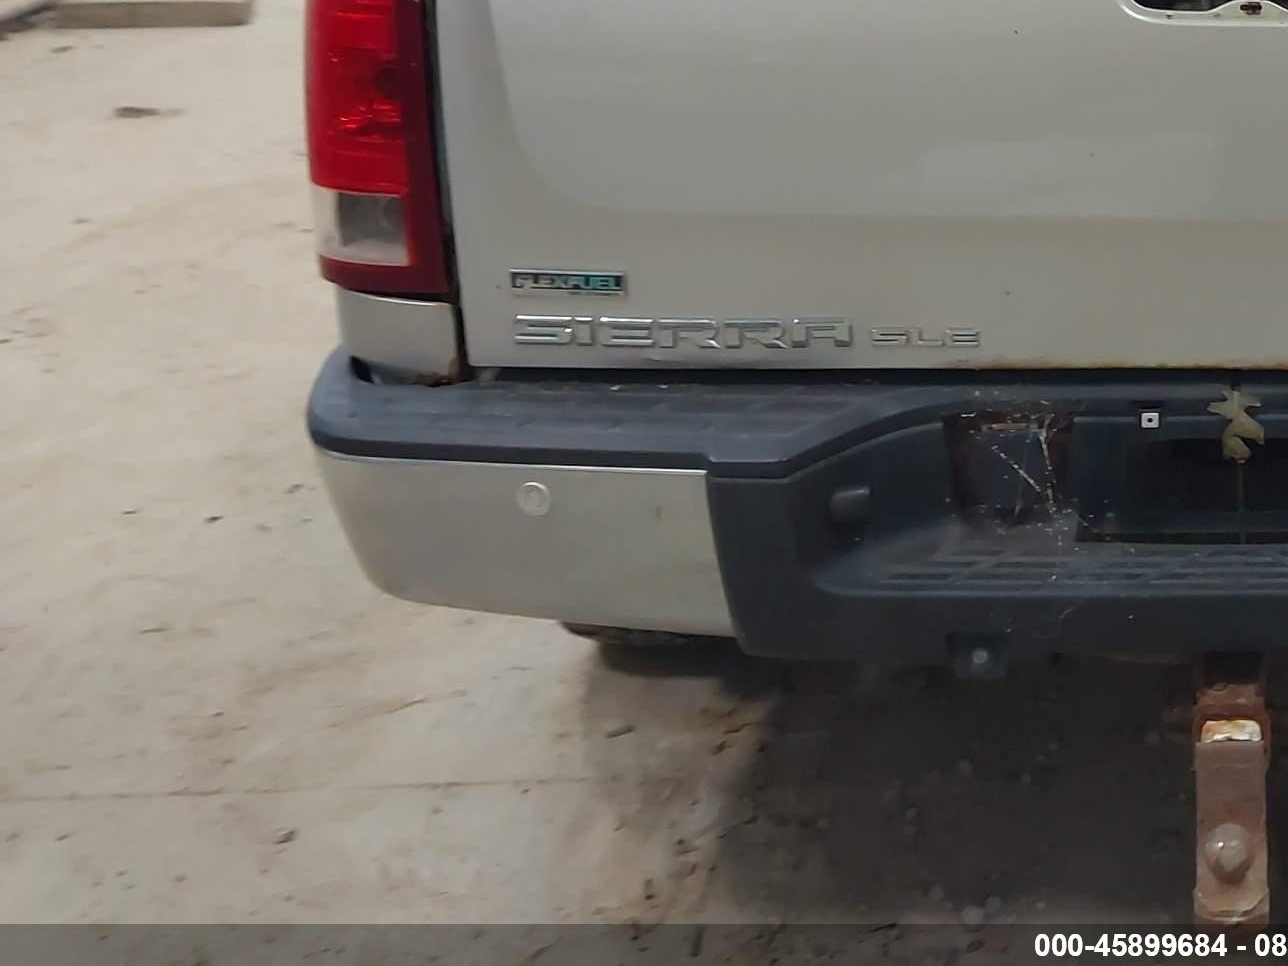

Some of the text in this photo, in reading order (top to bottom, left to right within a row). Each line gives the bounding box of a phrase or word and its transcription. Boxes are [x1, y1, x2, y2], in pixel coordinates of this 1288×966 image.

[513, 274, 621, 290] FLEXFUEL
[514, 314, 982, 349] SIERRA SLE
